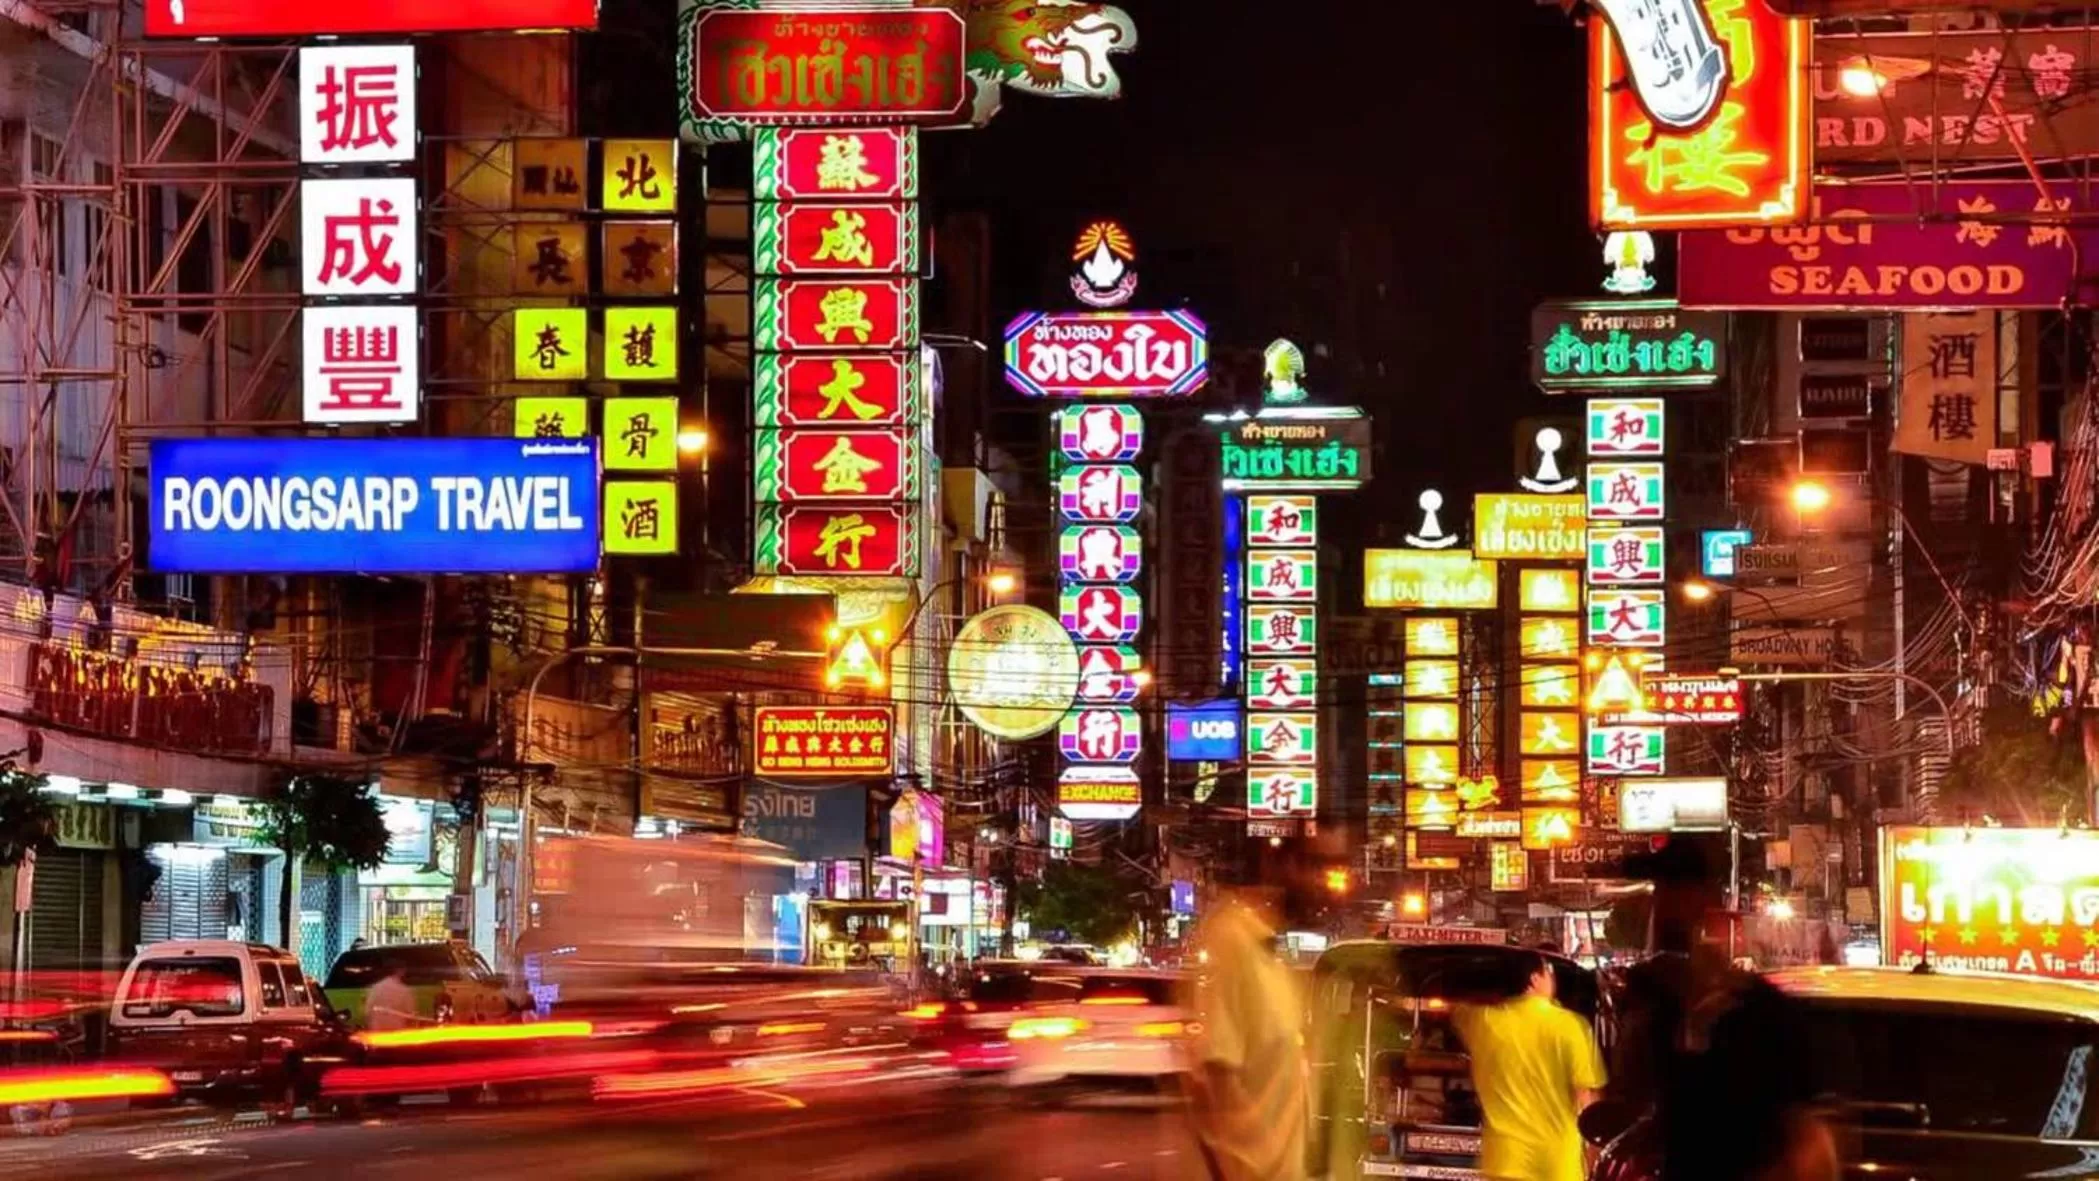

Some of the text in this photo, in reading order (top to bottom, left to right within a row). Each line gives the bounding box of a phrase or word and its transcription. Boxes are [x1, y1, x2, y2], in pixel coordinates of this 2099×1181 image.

[1903, 113, 2035, 145] NEST
[316, 64, 402, 411] 振成豐
[1769, 266, 2024, 295] SEAFOOD
[1027, 324, 1186, 382] ทองใบ
[1927, 311, 1977, 442] 酒樓
[164, 475, 583, 532] ROONGSARP TRAVEL
[1610, 411, 1645, 765] 和成興大行
[1265, 506, 1301, 811] 和成興大金行
[1191, 720, 1237, 739] UOB
[1060, 783, 1137, 801] EXCHANGE
[2015, 950, 2037, 971] A
